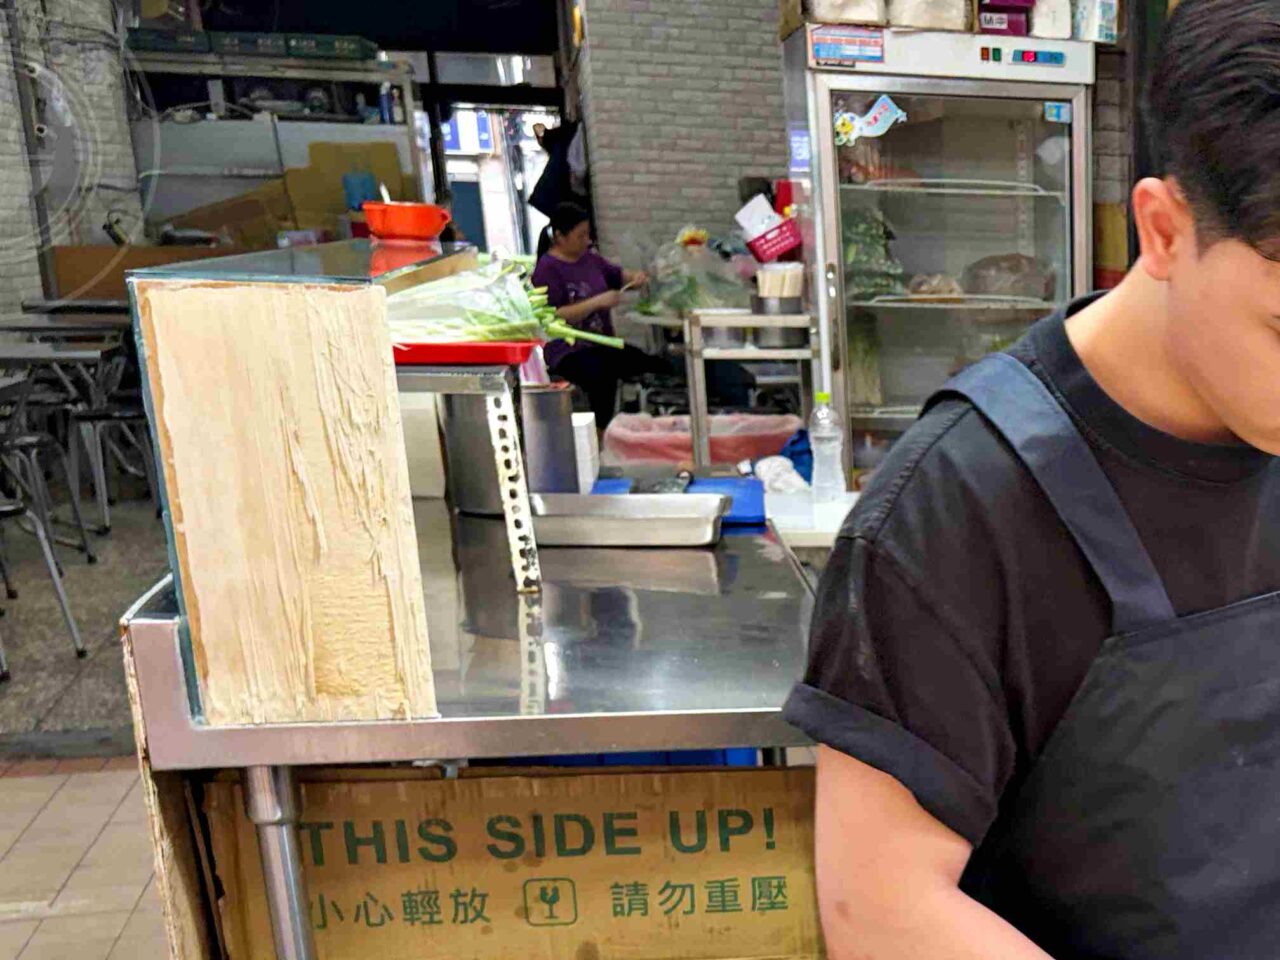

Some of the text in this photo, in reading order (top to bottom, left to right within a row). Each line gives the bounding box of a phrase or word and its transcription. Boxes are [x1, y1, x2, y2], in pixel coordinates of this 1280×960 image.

[298, 808, 776, 866] THIS SIDE UP!
[309, 875, 789, 930] 小心輕放 請勿重壓
